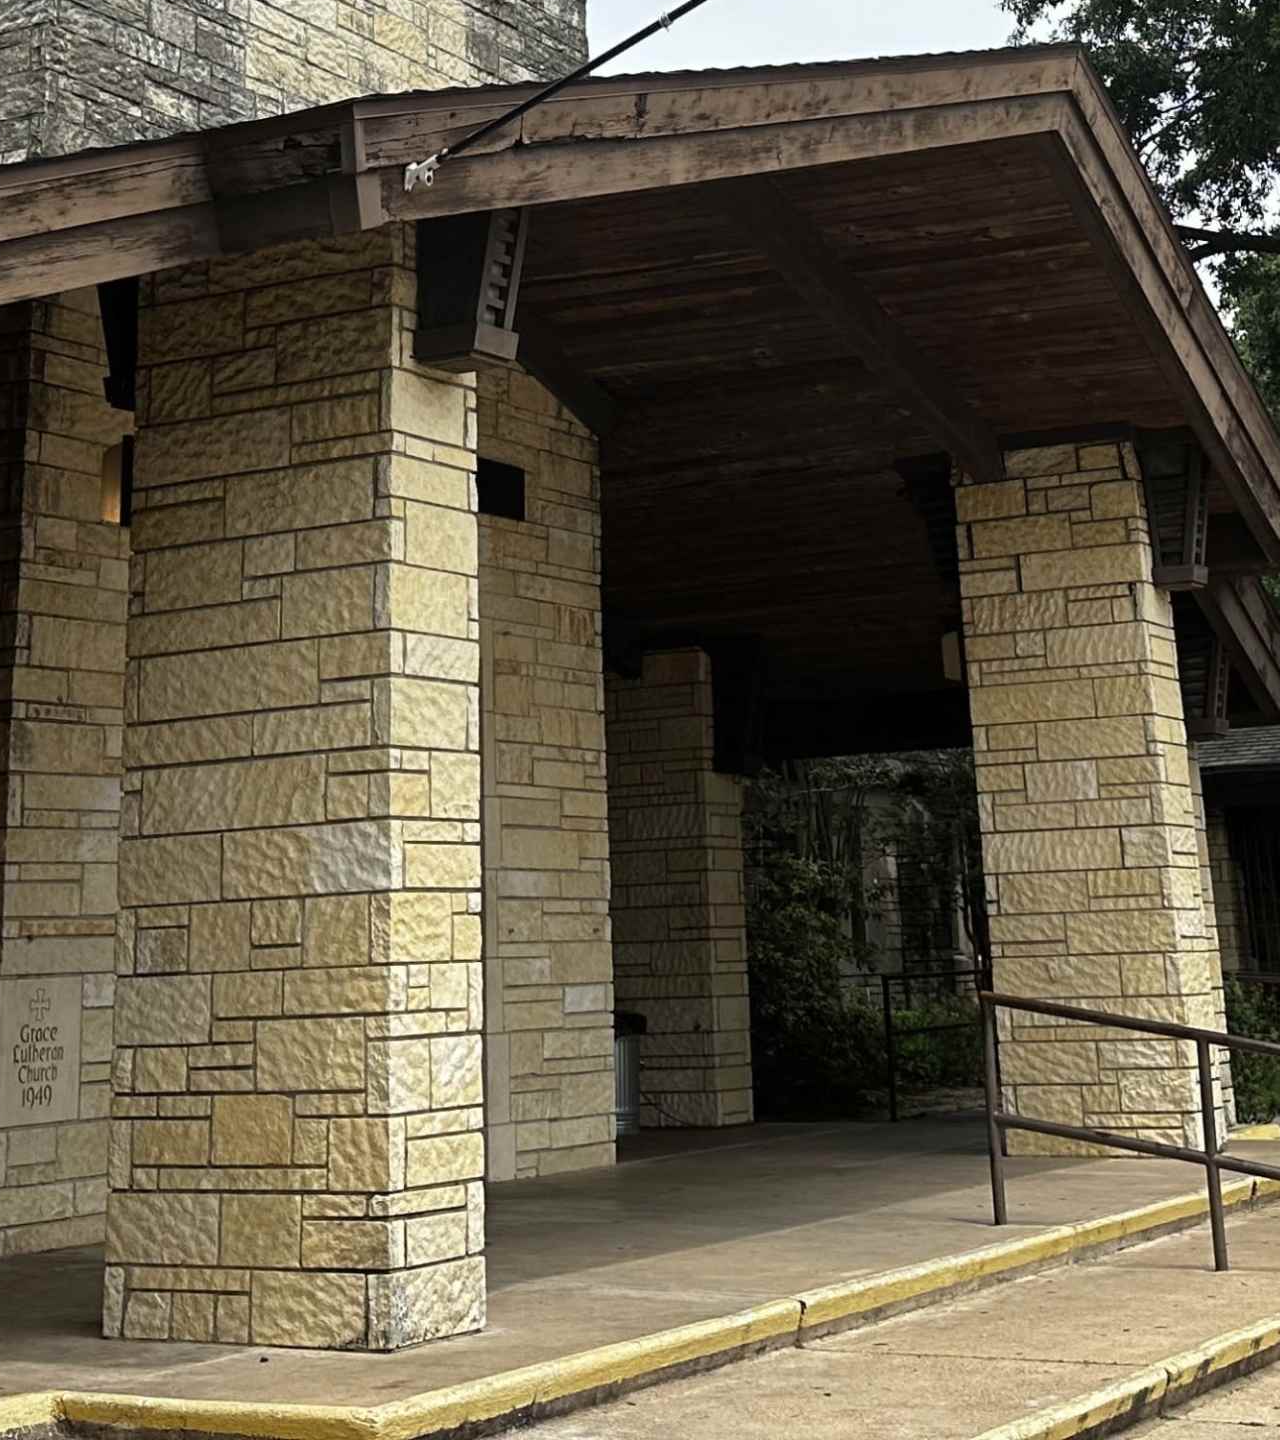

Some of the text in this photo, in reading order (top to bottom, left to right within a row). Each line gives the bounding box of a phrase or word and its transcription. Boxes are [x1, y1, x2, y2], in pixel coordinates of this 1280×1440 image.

[20, 1024, 58, 1043] Grace
[13, 1044, 64, 1063] Lutheran
[18, 1064, 58, 1085] Church
[22, 1085, 53, 1109] 1949
